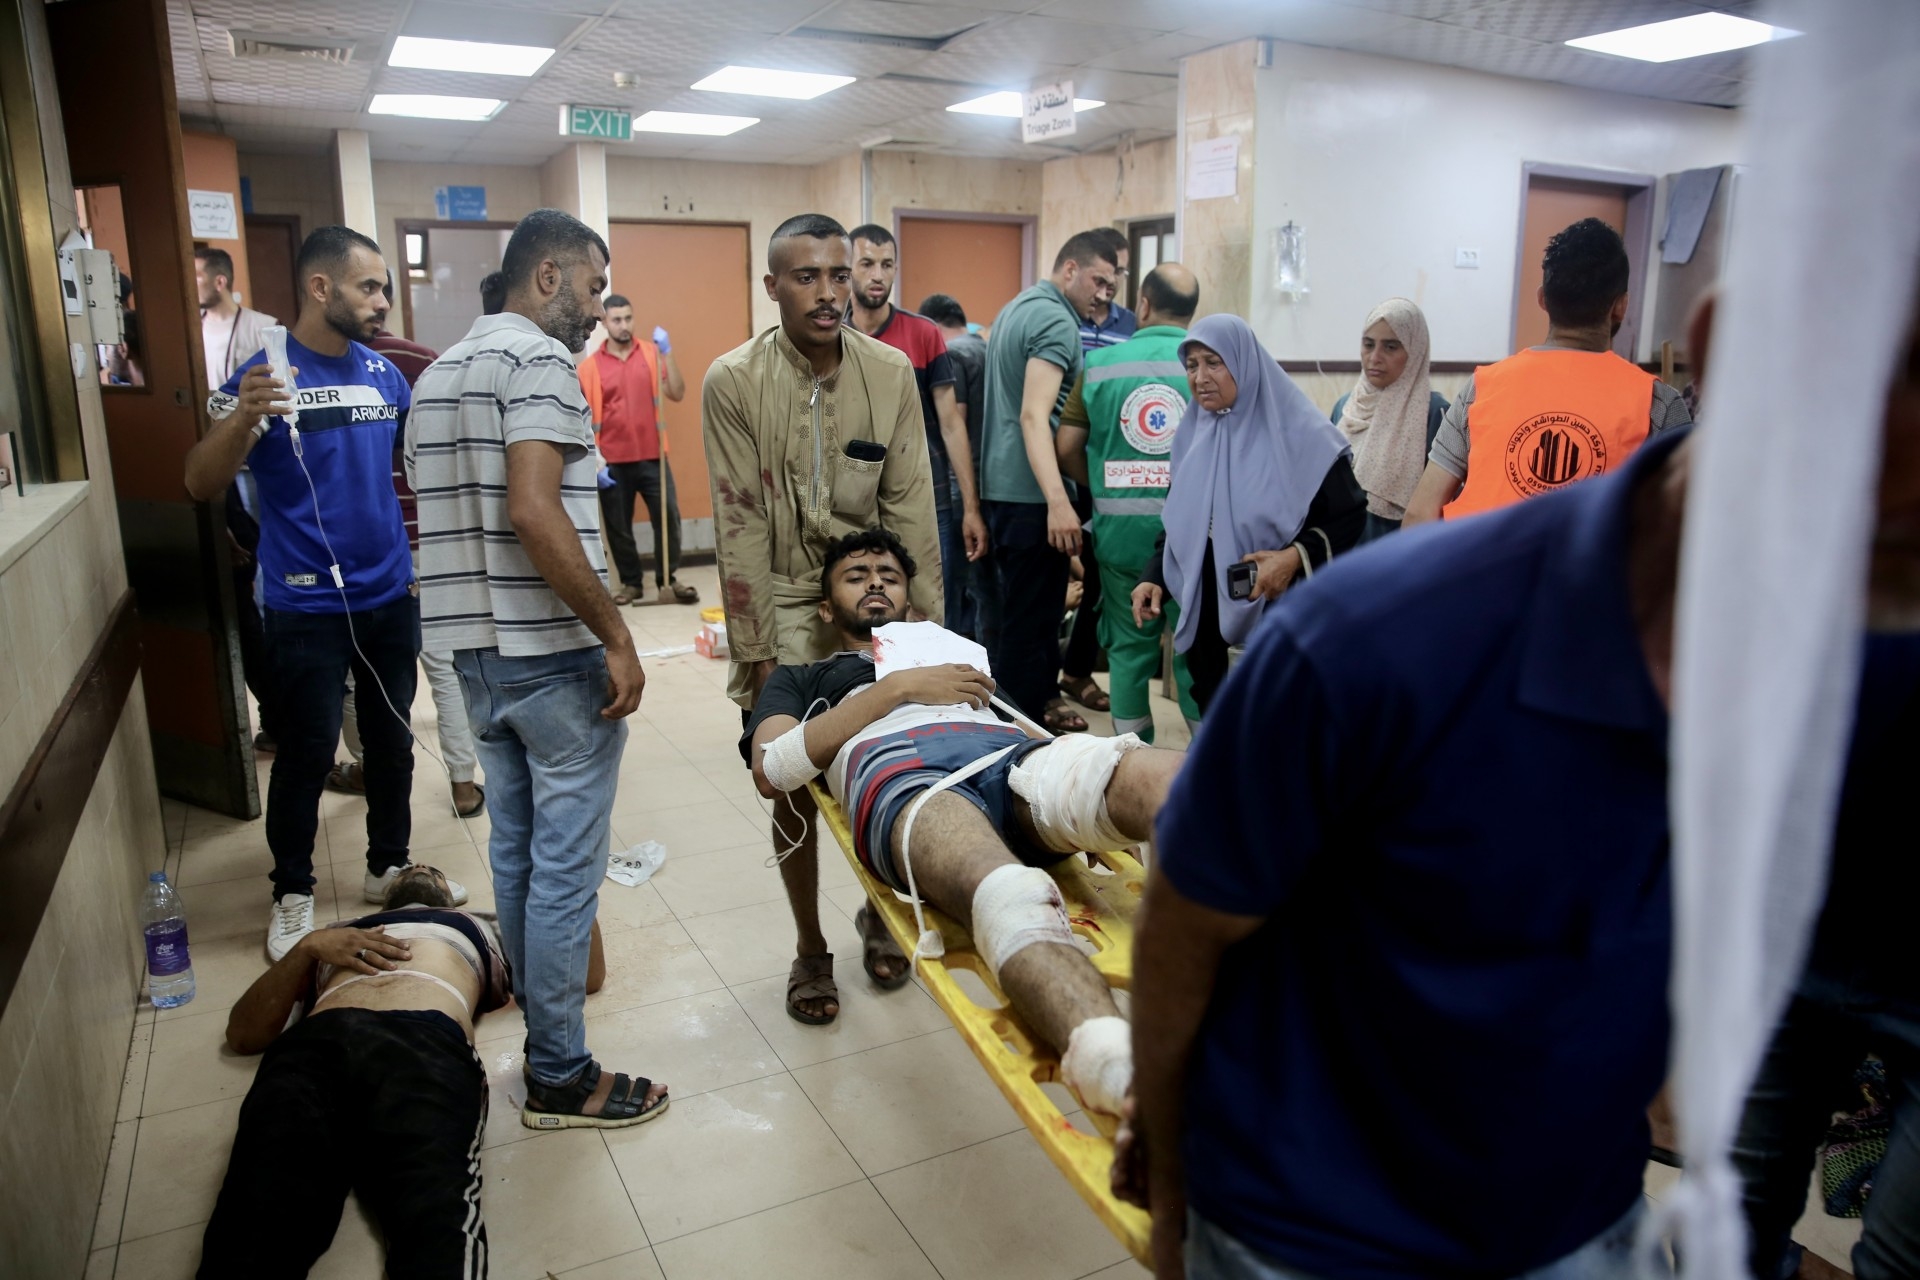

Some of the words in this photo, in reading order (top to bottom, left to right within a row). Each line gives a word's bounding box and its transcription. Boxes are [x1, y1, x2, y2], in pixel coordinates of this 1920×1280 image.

[1041, 93, 1068, 109] منطقة
[572, 107, 629, 137] EXIT
[1027, 123, 1050, 136] Triage
[1052, 118, 1072, 130] Zone
[297, 389, 341, 405] DER
[352, 406, 398, 421] ARMOUR
[1531, 415, 1570, 428] الطواشي
[1570, 418, 1591, 435] حسين
[1589, 433, 1605, 458] شركة
